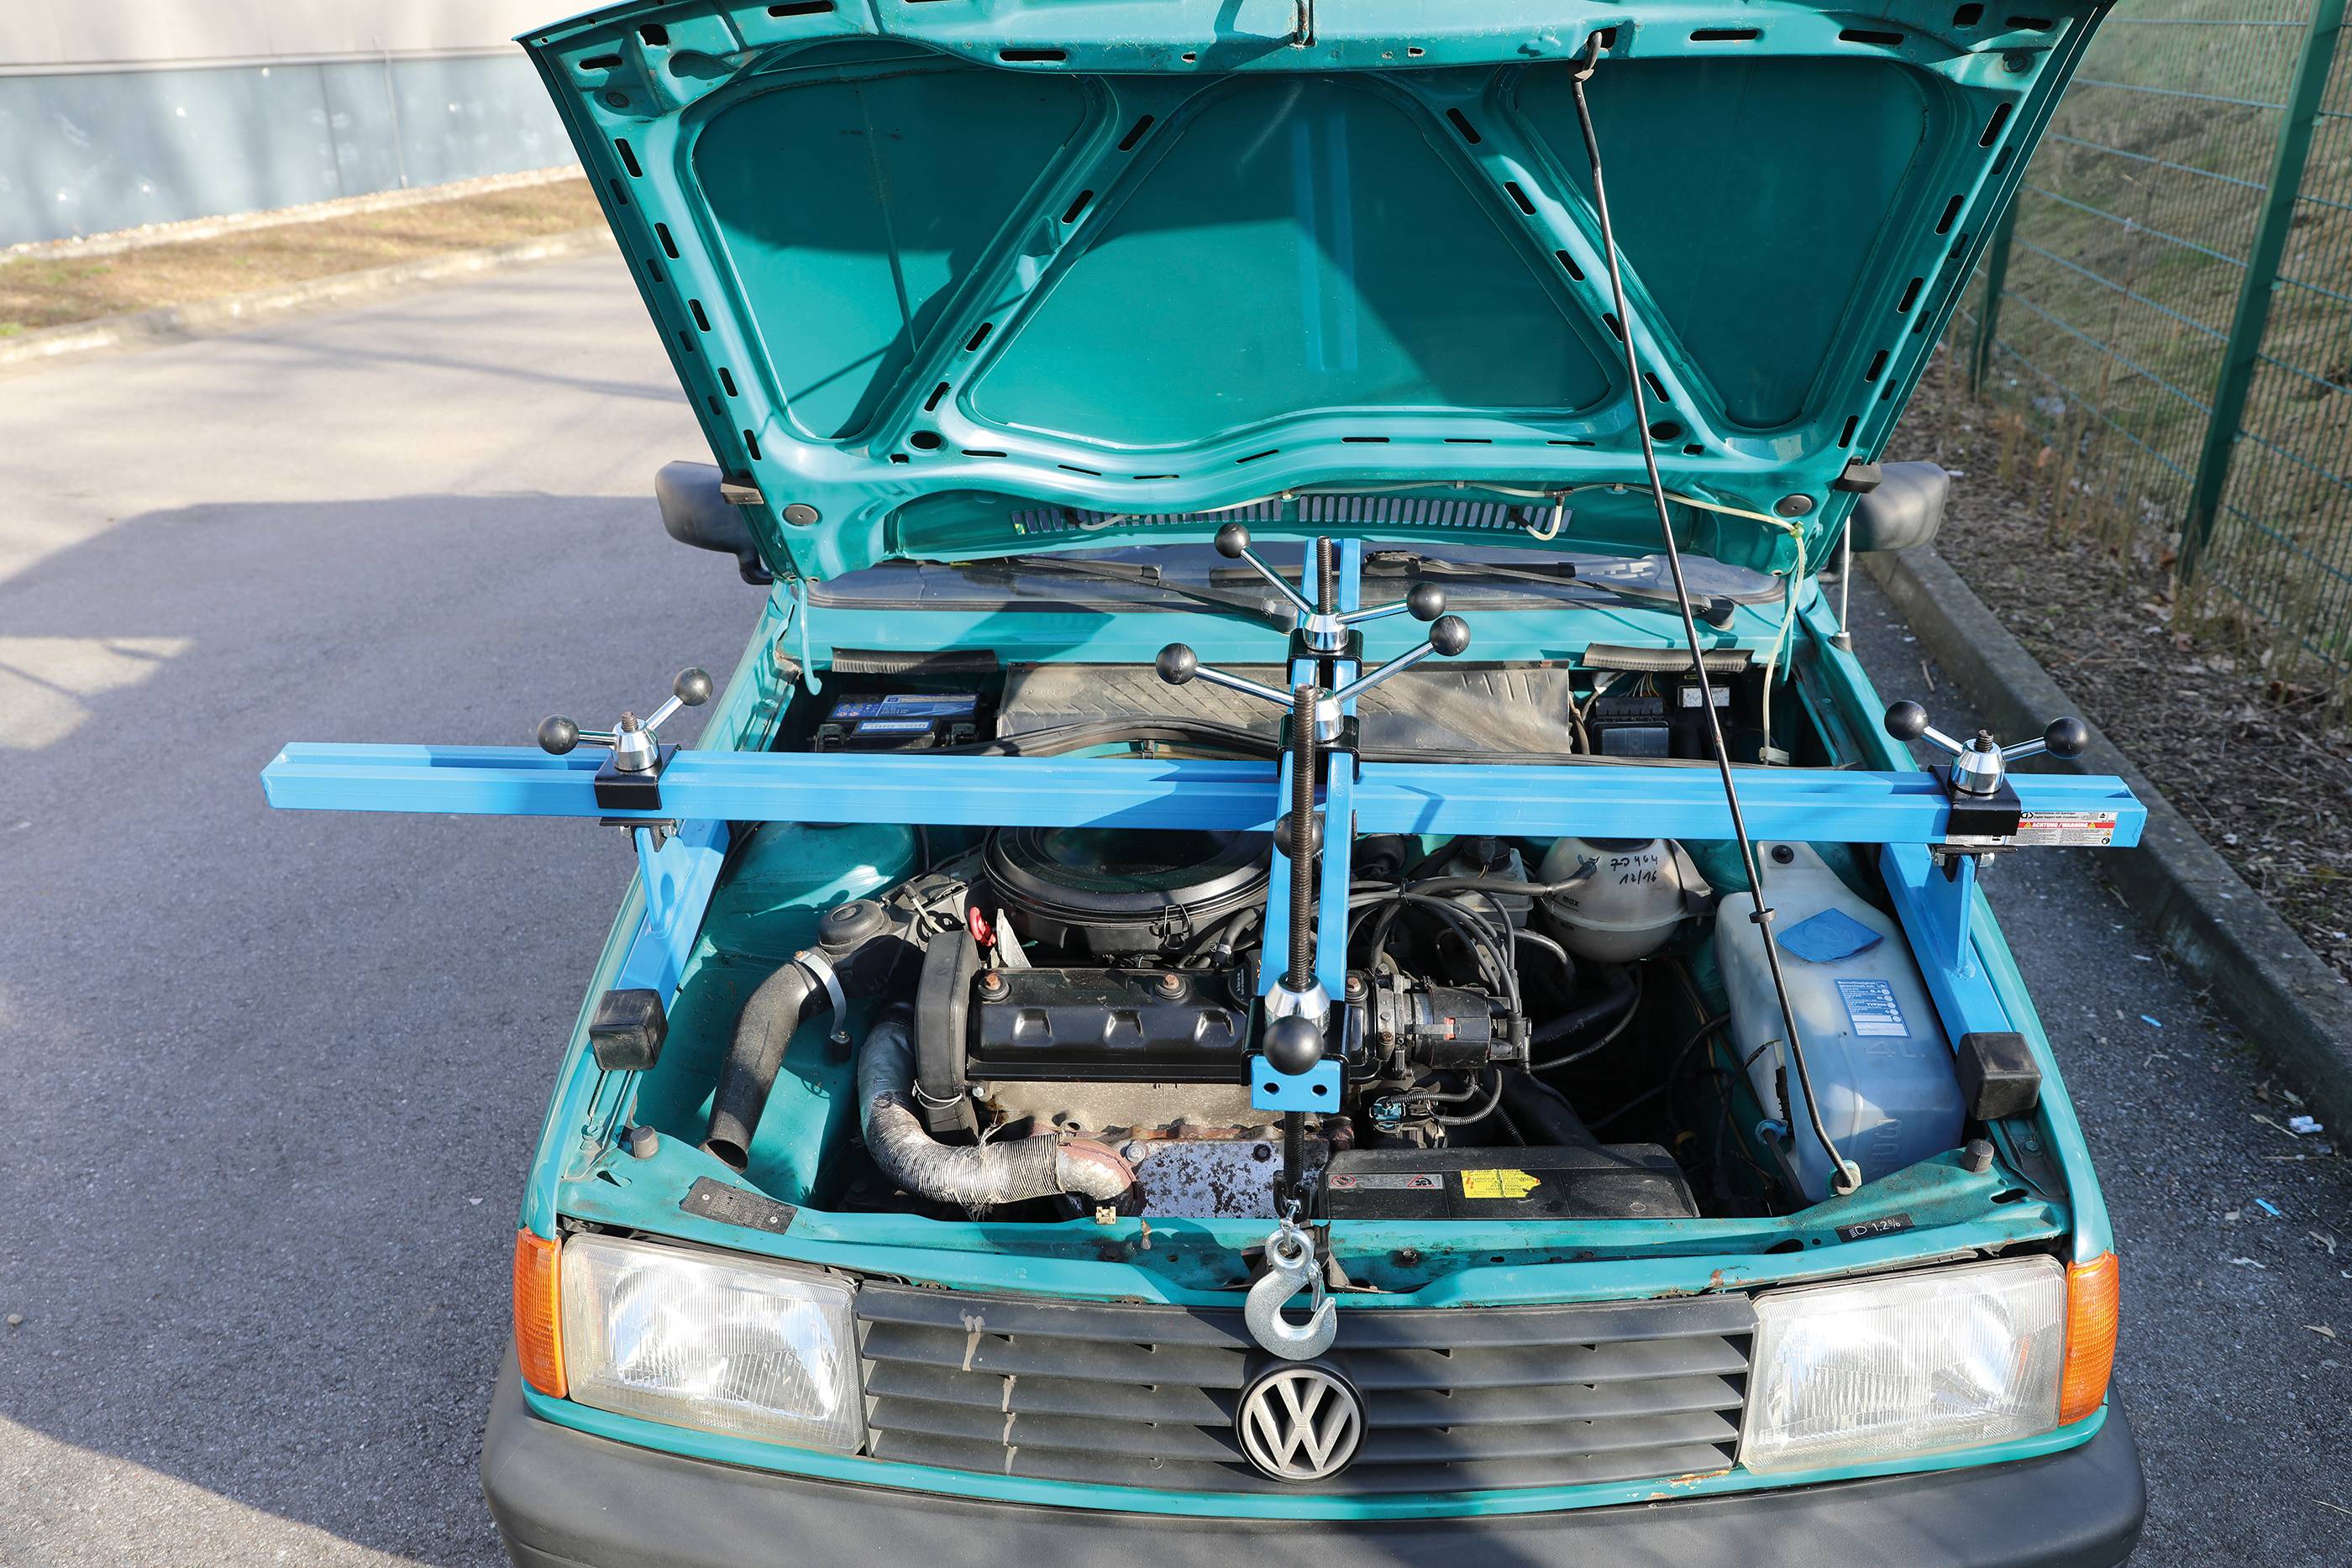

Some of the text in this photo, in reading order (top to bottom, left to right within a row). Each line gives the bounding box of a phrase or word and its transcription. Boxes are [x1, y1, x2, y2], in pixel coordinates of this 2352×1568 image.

[1562, 895, 1580, 907] max
[1872, 1218, 1901, 1232] 1.2%
[1243, 1370, 1360, 1479] VW
